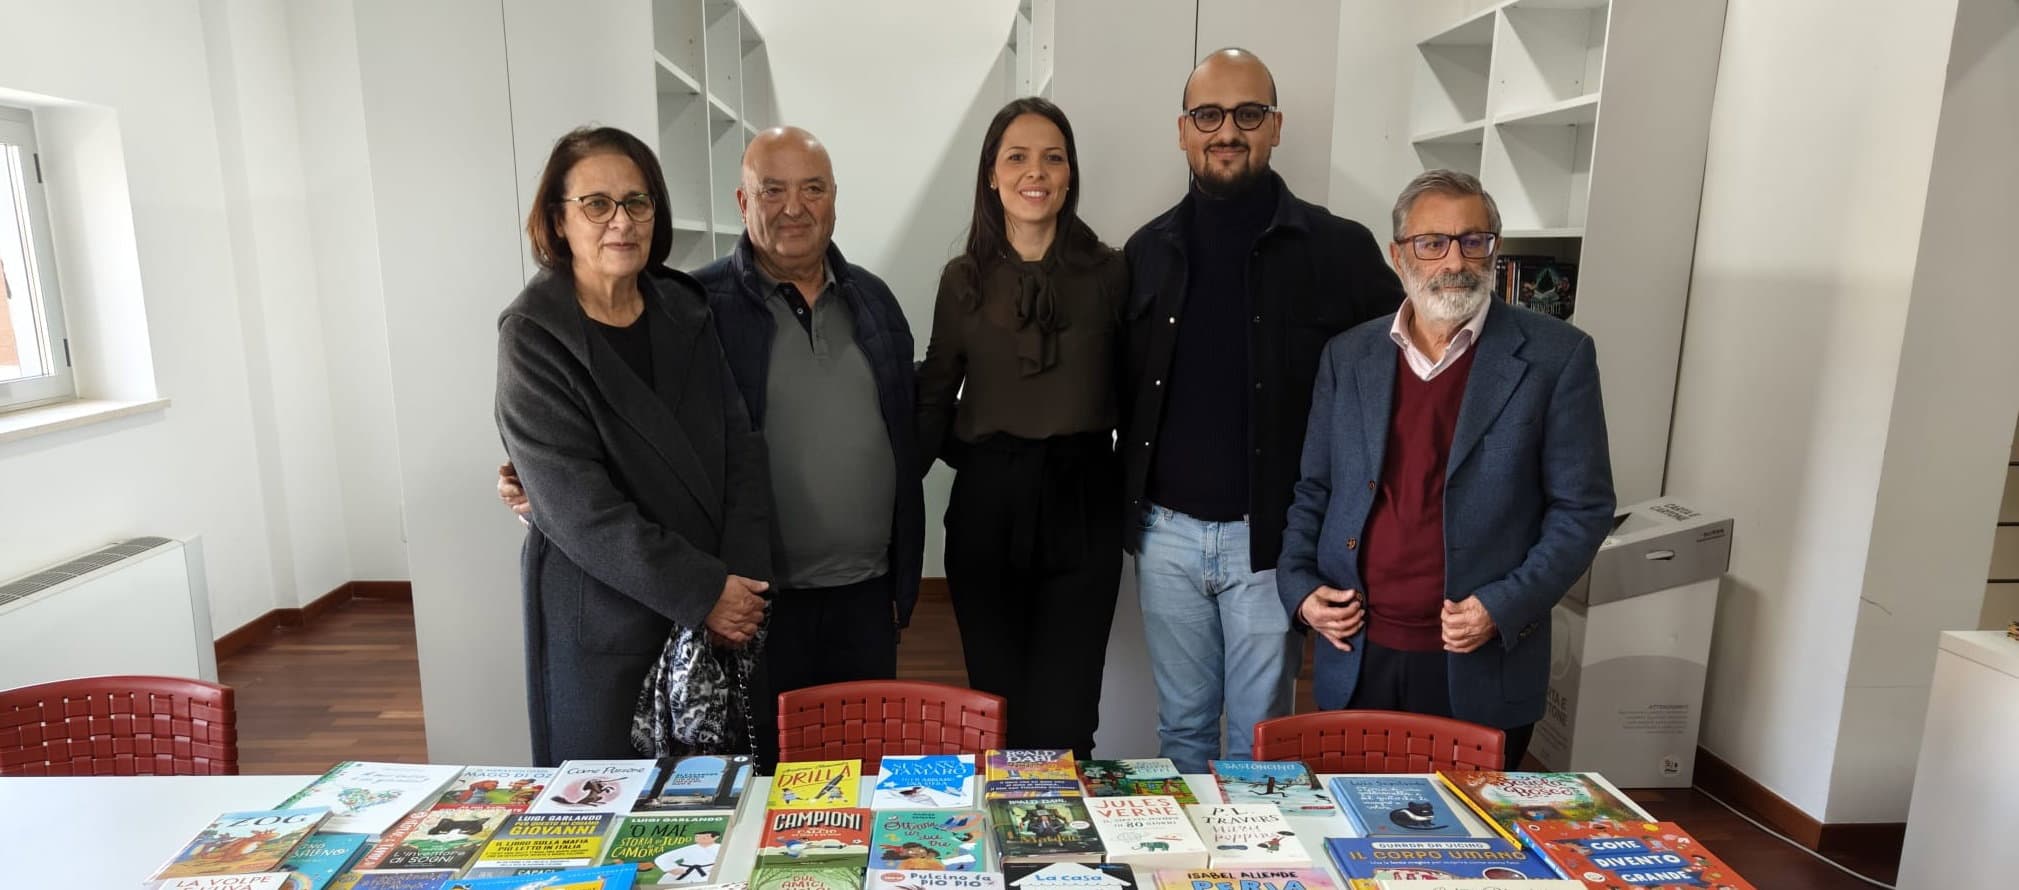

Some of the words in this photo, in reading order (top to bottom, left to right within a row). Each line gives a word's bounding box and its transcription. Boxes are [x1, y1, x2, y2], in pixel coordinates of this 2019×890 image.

[1006, 750, 1056, 758] ROALD
[892, 765, 967, 776] TAMARO
[1096, 799, 1172, 808] JULES
[1097, 807, 1177, 818] VERNE
[226, 813, 309, 828] ZOG
[773, 811, 863, 832] CAMPIONI
[1202, 815, 1280, 824] TRAVERS
[509, 825, 597, 836] GIOVANNI
[1590, 841, 1642, 850] COME
[1350, 851, 1367, 860] IL
[1373, 851, 1442, 860] CORPO
[1448, 851, 1527, 861] UMANO
[1595, 854, 1682, 868] DIVENTO
[1188, 872, 1237, 880] ISABEL
[1241, 871, 1299, 879] ALLENDE
[1620, 869, 1691, 883] GRANDE
[177, 879, 199, 888] LA
[209, 876, 273, 886] VOLPE
